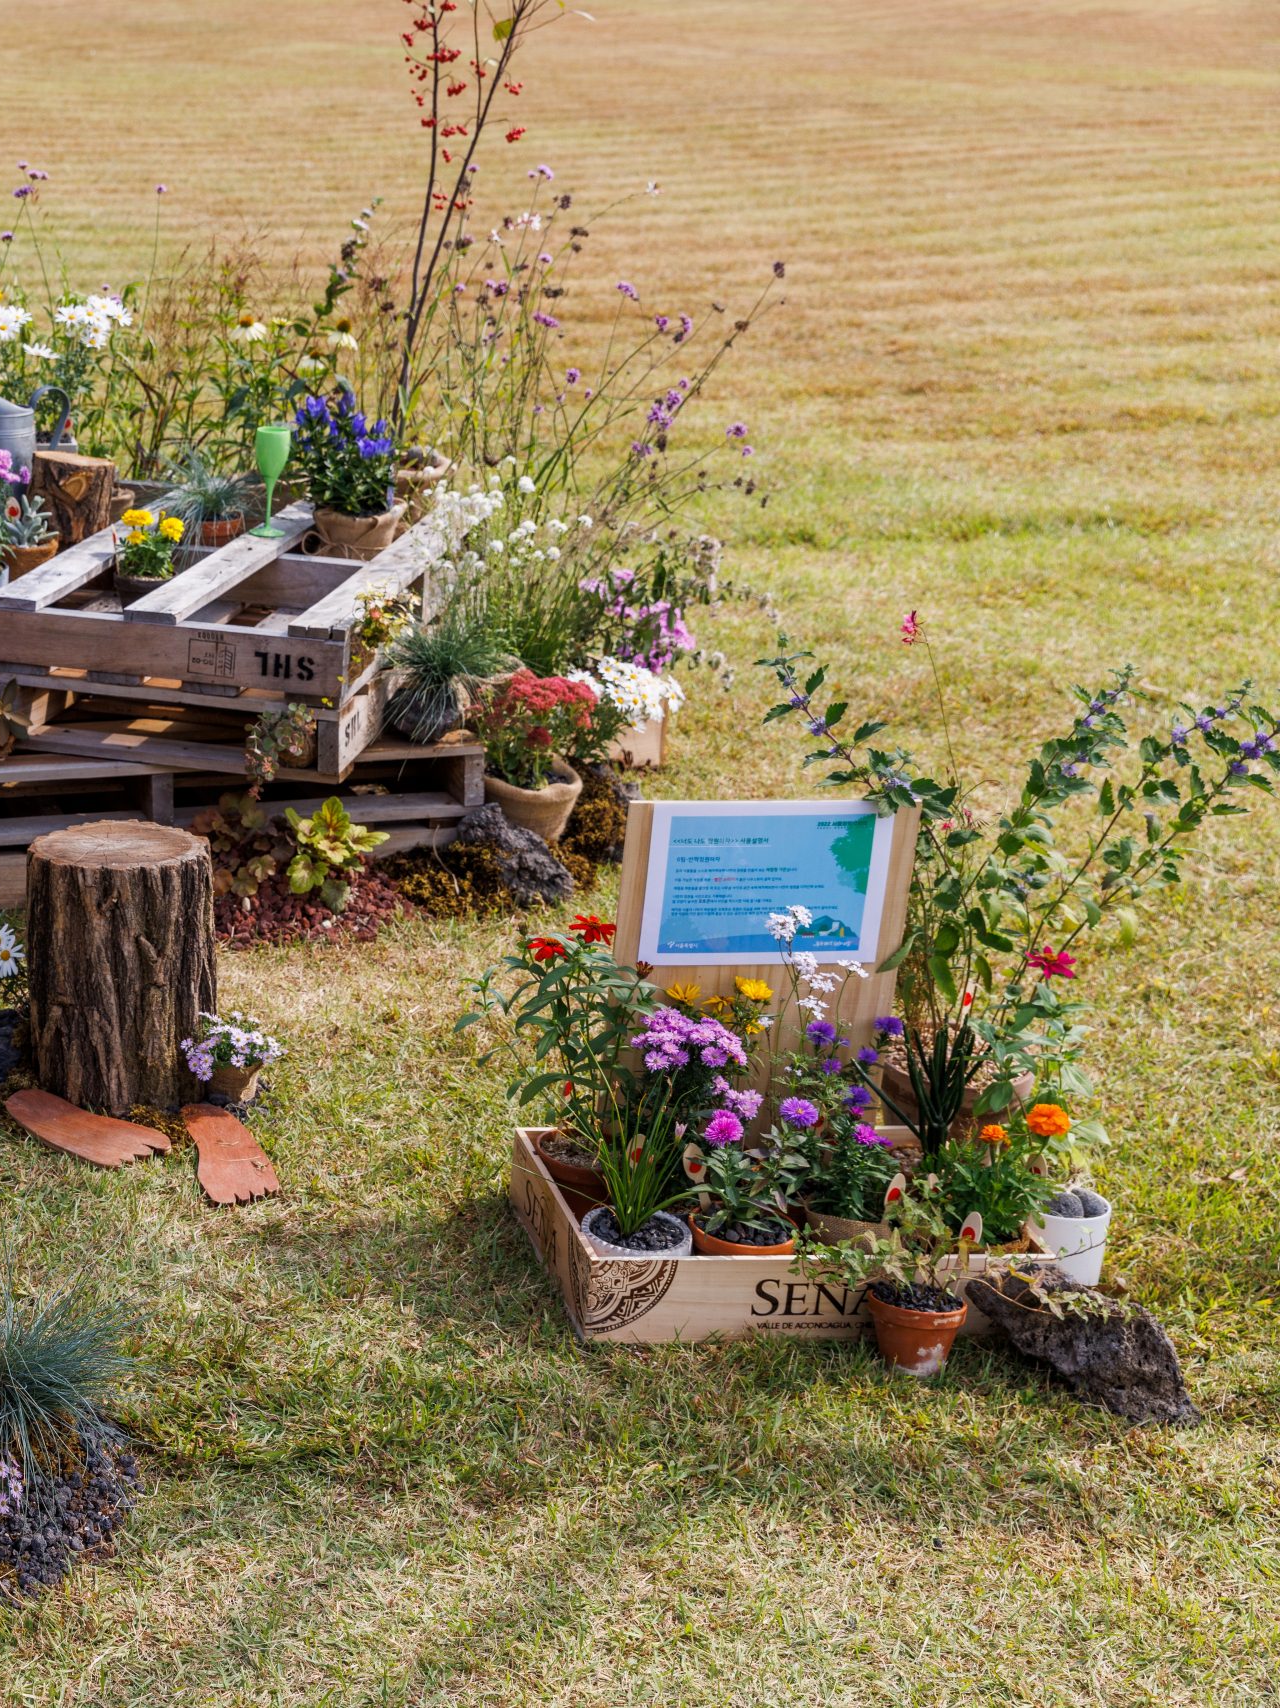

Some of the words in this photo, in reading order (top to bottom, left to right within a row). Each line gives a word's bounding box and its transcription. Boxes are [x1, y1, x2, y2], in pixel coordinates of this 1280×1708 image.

[254, 651, 315, 681] SHL
[757, 1322, 780, 1330] VALLE
[782, 1322, 792, 1330] DE
